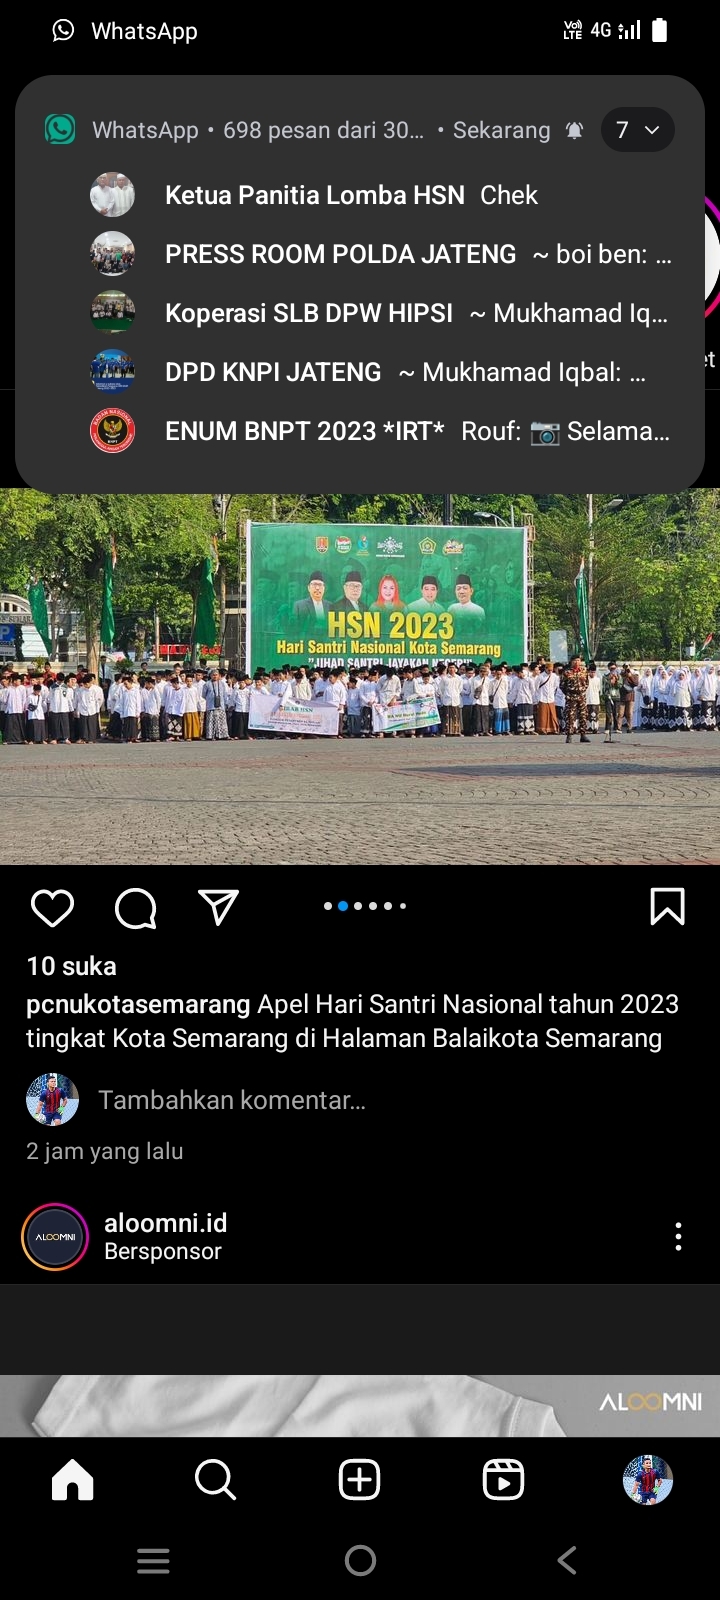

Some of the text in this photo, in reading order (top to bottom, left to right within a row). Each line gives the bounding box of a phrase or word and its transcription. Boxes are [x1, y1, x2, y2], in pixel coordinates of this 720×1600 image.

[92, 20, 197, 44] WhatsApp
[564, 30, 582, 39] LTE
[591, 21, 611, 38] 4G
[93, 120, 198, 143] WhatsApp
[224, 121, 261, 139] 698
[269, 124, 329, 143] pesan
[338, 120, 375, 139] dari
[454, 120, 550, 143] Sekarang
[617, 121, 628, 138] 7
[167, 184, 538, 205] Ketua Panitia Lomba HSN Chek
[167, 244, 244, 264] PRESS
[253, 244, 324, 264] ROOM
[334, 244, 415, 264] POLDA
[422, 244, 515, 264] JATENG
[557, 243, 591, 264] boi
[599, 243, 646, 264] ben:
[167, 302, 265, 328] Koperasi
[274, 303, 318, 323] SLB
[327, 303, 382, 323] DPW
[390, 303, 452, 323] HIPSI
[495, 302, 621, 323] Mukhamad
[167, 362, 215, 382] DPD
[224, 362, 279, 382] KNPI
[287, 362, 380, 382] JATENG
[424, 361, 550, 382] Mukhamad
[560, 361, 620, 387] Iqbal:
[167, 421, 236, 441] ENUM
[246, 421, 311, 441] BNPT
[318, 421, 376, 441] 2023
[463, 420, 520, 441] Rouf:
[328, 611, 454, 639] HSN 2023
[277, 640, 501, 658] Hari Santri Nasional Kota Semarang
[28, 955, 117, 976] 10 suka
[27, 993, 679, 1019] pcnukotasemarang Apel Hari Santri Nasional tahun 2023
[26, 1027, 661, 1053] tingkat Kota Semarang di Halaman Balaikota Semarang
[98, 1089, 233, 1110] Tambahkan
[27, 1142, 183, 1164] 2 jam yang lalu
[105, 1212, 227, 1234] aloomni.id
[105, 1242, 222, 1264] Bersponsor
[599, 1392, 702, 1411] ALOOMNI
